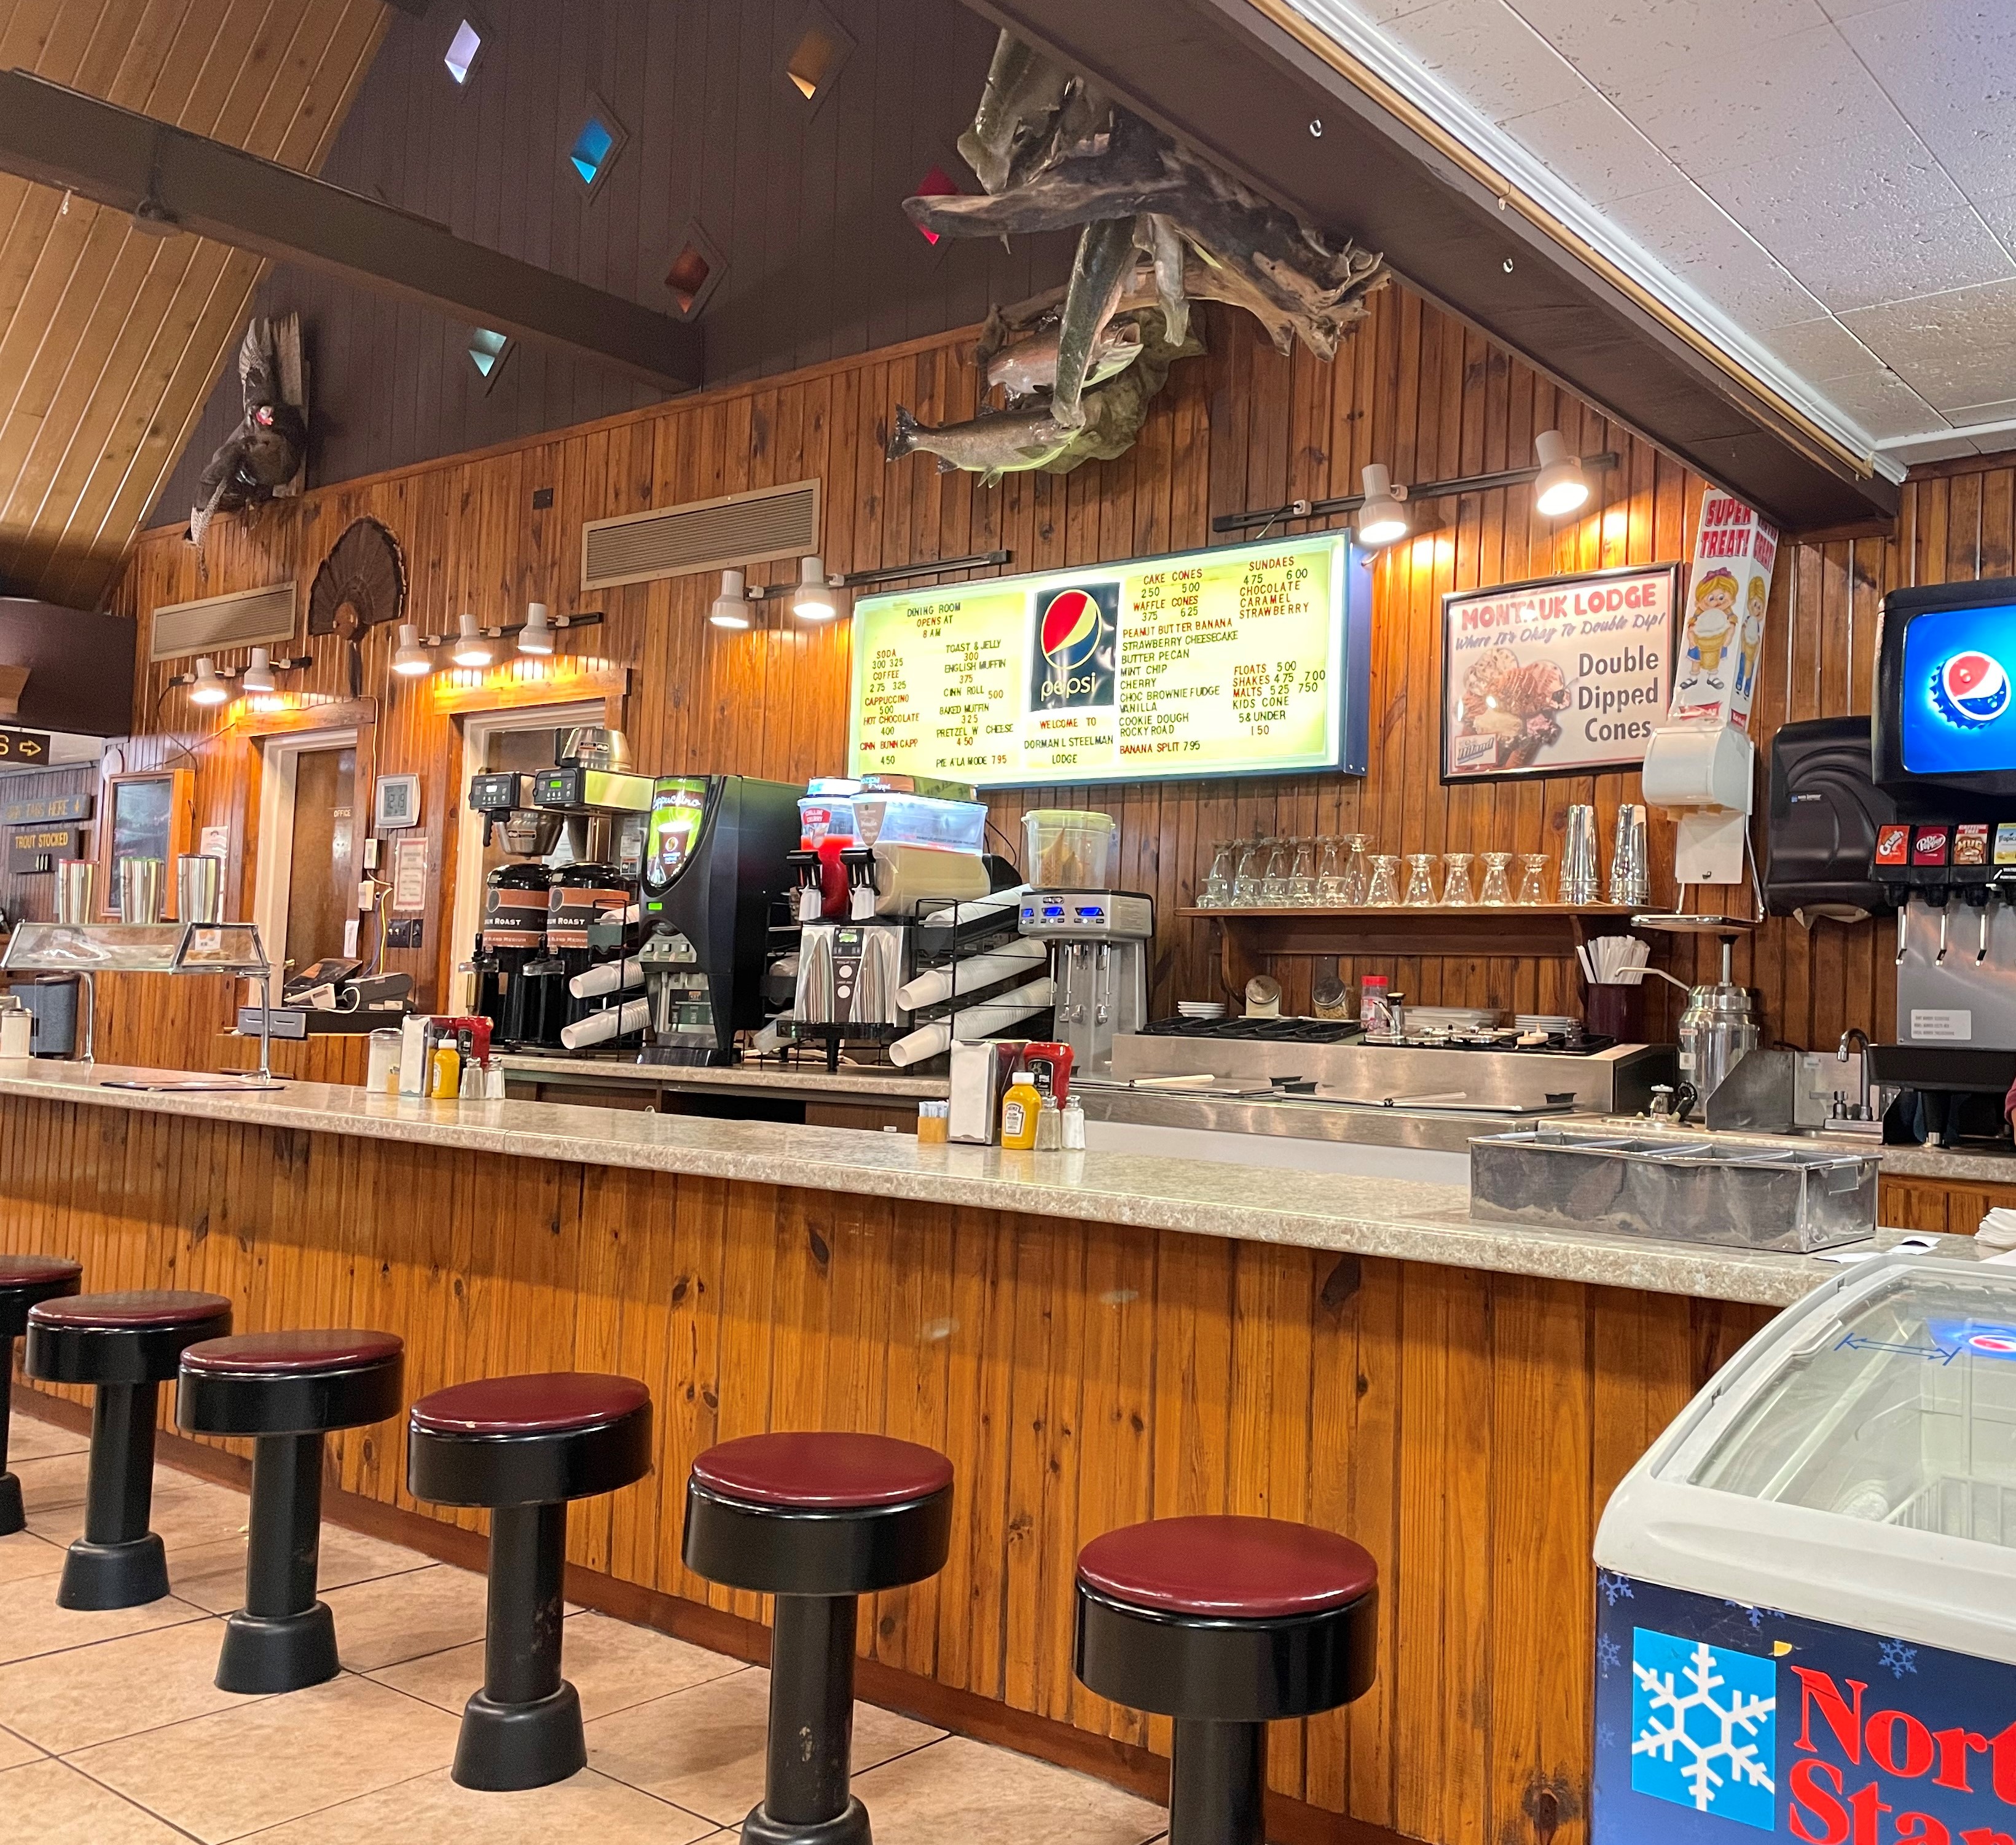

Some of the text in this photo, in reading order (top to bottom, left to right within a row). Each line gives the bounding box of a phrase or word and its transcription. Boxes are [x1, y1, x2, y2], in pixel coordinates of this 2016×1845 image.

[1705, 498, 1751, 527] SUPER
[1700, 529, 1751, 558] TREAT!
[1249, 556, 1294, 571] SUNDAES
[1144, 568, 1202, 585] CAKE CONES
[1142, 582, 1199, 598] 250 500
[1240, 580, 1301, 597] CHOCOLATE
[1134, 595, 1198, 611] WAFFLE CONES
[1241, 593, 1291, 608] CARAMEL
[1574, 584, 1656, 616] LODGE
[908, 602, 960, 617] DINING ROOM
[1142, 606, 1198, 621] 375 625
[1239, 602, 1309, 619] STRAWBERRY
[917, 615, 953, 627] OPENS AT
[1123, 618, 1232, 638] PEANUT BUTTER BANANA
[923, 628, 941, 638] 8 AM
[1456, 635, 1491, 650] Where
[1520, 627, 1557, 644] Okay
[1561, 623, 1576, 637] To
[1580, 615, 1628, 635] Double
[1633, 612, 1666, 632] Dip!
[946, 639, 1001, 653] TOAST & JELLY
[1123, 630, 1239, 651] STRAWBERRY CHEESECAKE
[877, 649, 896, 659] SODA
[964, 652, 978, 661] 300
[1121, 649, 1190, 664] BUTTER PECAN
[1579, 645, 1659, 677] Double
[873, 658, 903, 669] 300 325
[944, 659, 1006, 673] ENGLISH MUFFIN
[1121, 664, 1167, 676] MINT CHIP
[1234, 660, 1296, 675] FLOATS 500
[873, 670, 900, 680] COFFEE
[959, 675, 973, 684] 375
[1233, 675, 1270, 687] SHAKES
[893, 681, 906, 690] 325
[1040, 672, 1096, 702] pepsi
[1121, 678, 1156, 690] CHERRY
[1233, 687, 1262, 697] MALTS
[1298, 682, 1318, 693] 750
[944, 686, 1003, 699] CINN ROLL 500
[1120, 686, 1220, 702] CHOC BROWNIE FUDGE
[1579, 677, 1658, 714] Dipped
[865, 694, 909, 706] CAPPUCCINO
[1233, 696, 1289, 710] KIDS CONE
[880, 705, 893, 715] 500
[939, 703, 989, 715] BAKED MUFFIN
[1120, 702, 1157, 713] VANILLA
[863, 713, 919, 726] HOT CHOCOLATE
[962, 715, 978, 724] 325
[1040, 717, 1096, 729] WELCOME TO
[1119, 713, 1189, 726] COOKIE DOUGH
[881, 727, 895, 735] 400
[936, 727, 967, 738] PRETZEL
[986, 724, 1013, 734] CHEESE
[1121, 724, 1174, 737] ROCKY ROAD
[1585, 718, 1651, 742] Cones
[900, 739, 918, 748] CAPP
[1024, 735, 1113, 749] DORMAN L STEELMAN
[1120, 740, 1200, 754] BANANA SPLIT 795
[936, 759, 947, 767] PIE
[968, 756, 987, 765] MODE
[992, 755, 1007, 764] 795
[1053, 754, 1077, 764] LODGE
[15, 832, 68, 848] TROUT STOCKED
[1958, 840, 1983, 851] MUG
[1790, 1758, 2016, 1845] Sta
